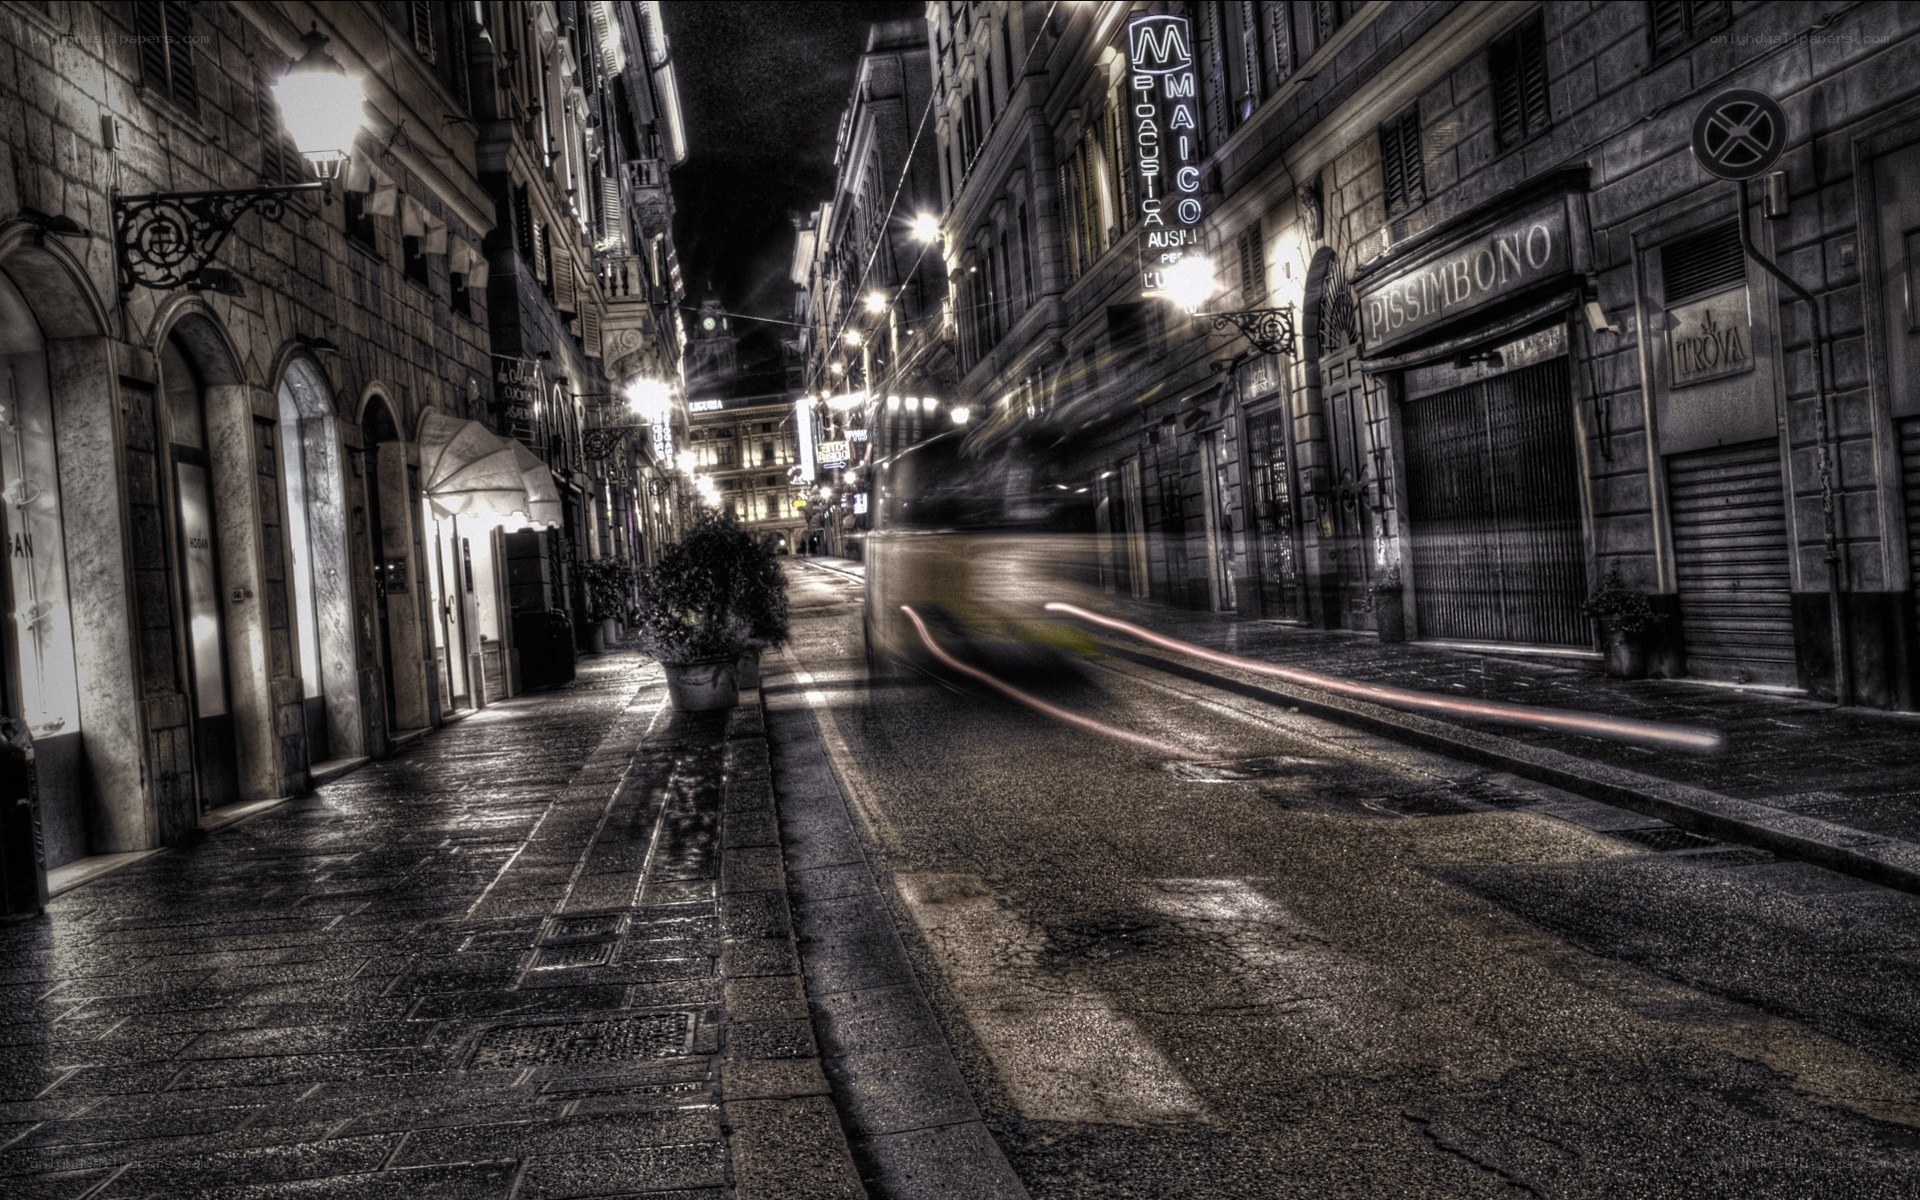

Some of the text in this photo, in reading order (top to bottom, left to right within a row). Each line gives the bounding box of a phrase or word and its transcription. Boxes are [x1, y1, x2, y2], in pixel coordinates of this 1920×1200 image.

[1134, 76, 1163, 226] BIOACUSTICA
[1165, 73, 1201, 224] MAICO
[1368, 223, 1551, 344] PISSIMBONO
